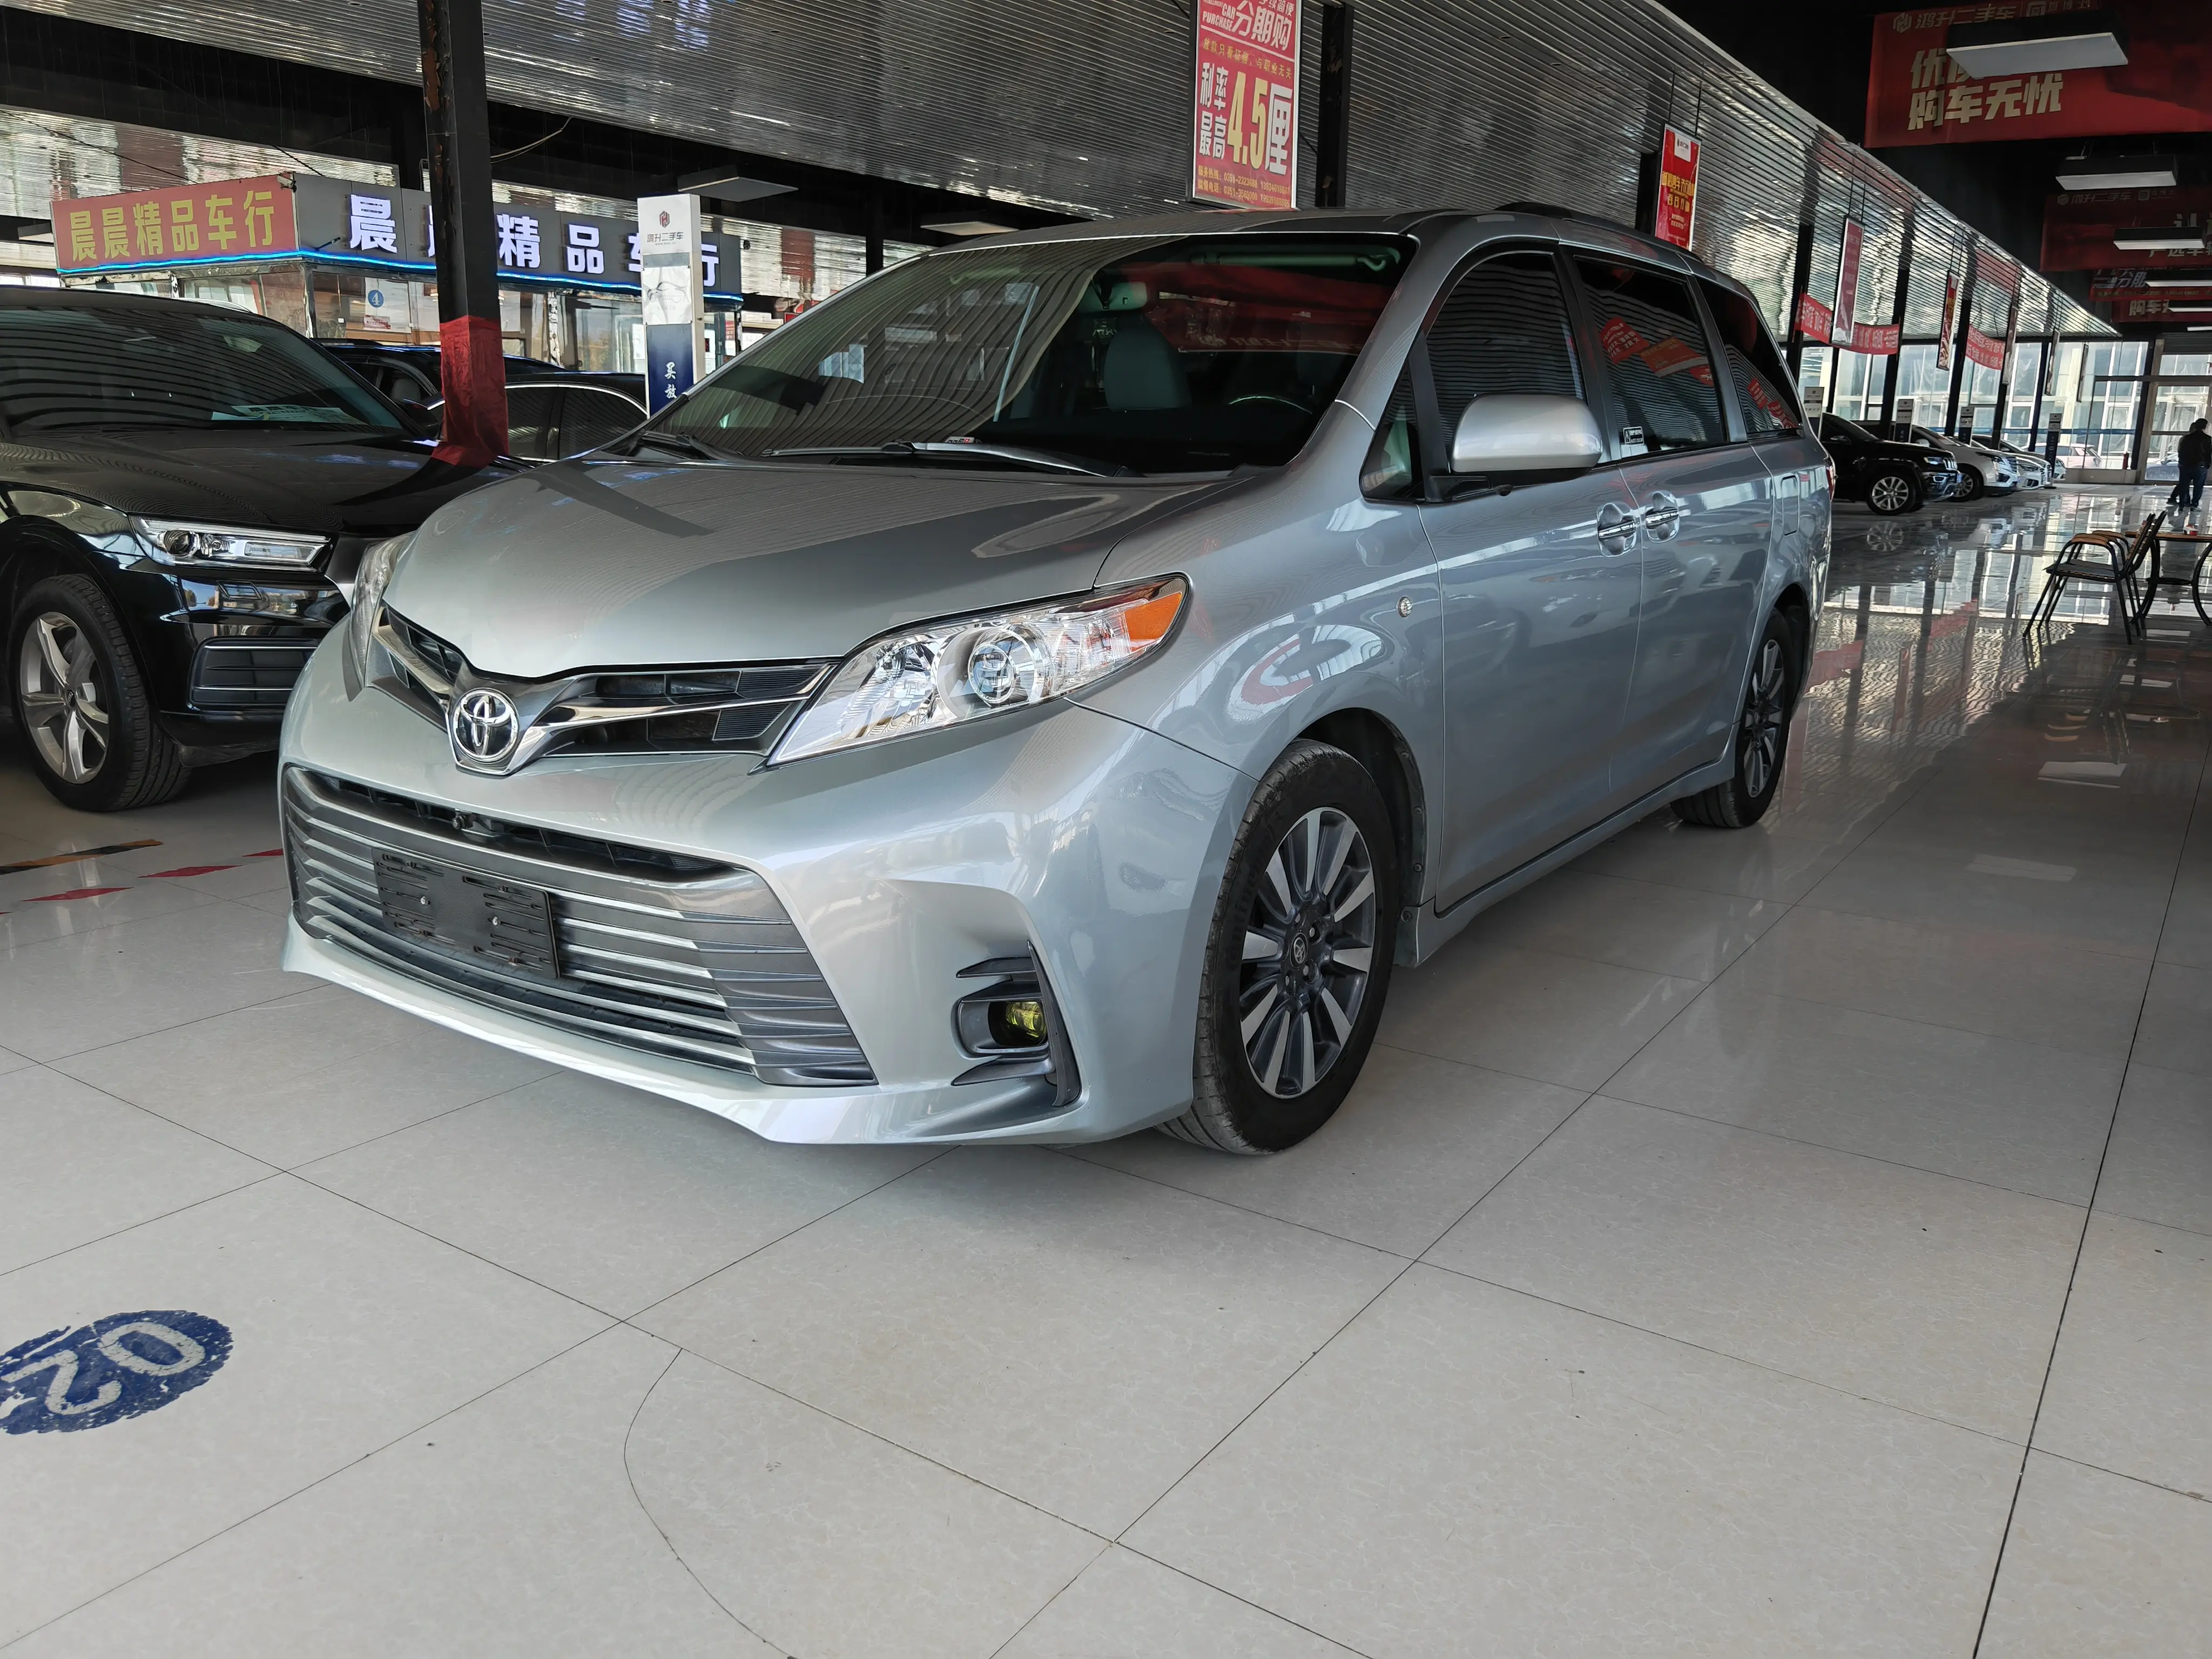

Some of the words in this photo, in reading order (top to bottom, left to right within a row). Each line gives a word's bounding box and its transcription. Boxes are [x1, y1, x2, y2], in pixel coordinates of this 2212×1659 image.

[1202, 11, 1233, 31] PURCHASE
[1222, 3, 1236, 20] CAR
[1907, 73, 2063, 131] 购车无忧
[70, 191, 274, 262] 晨晨精品车行
[372, 292, 380, 306] 4
